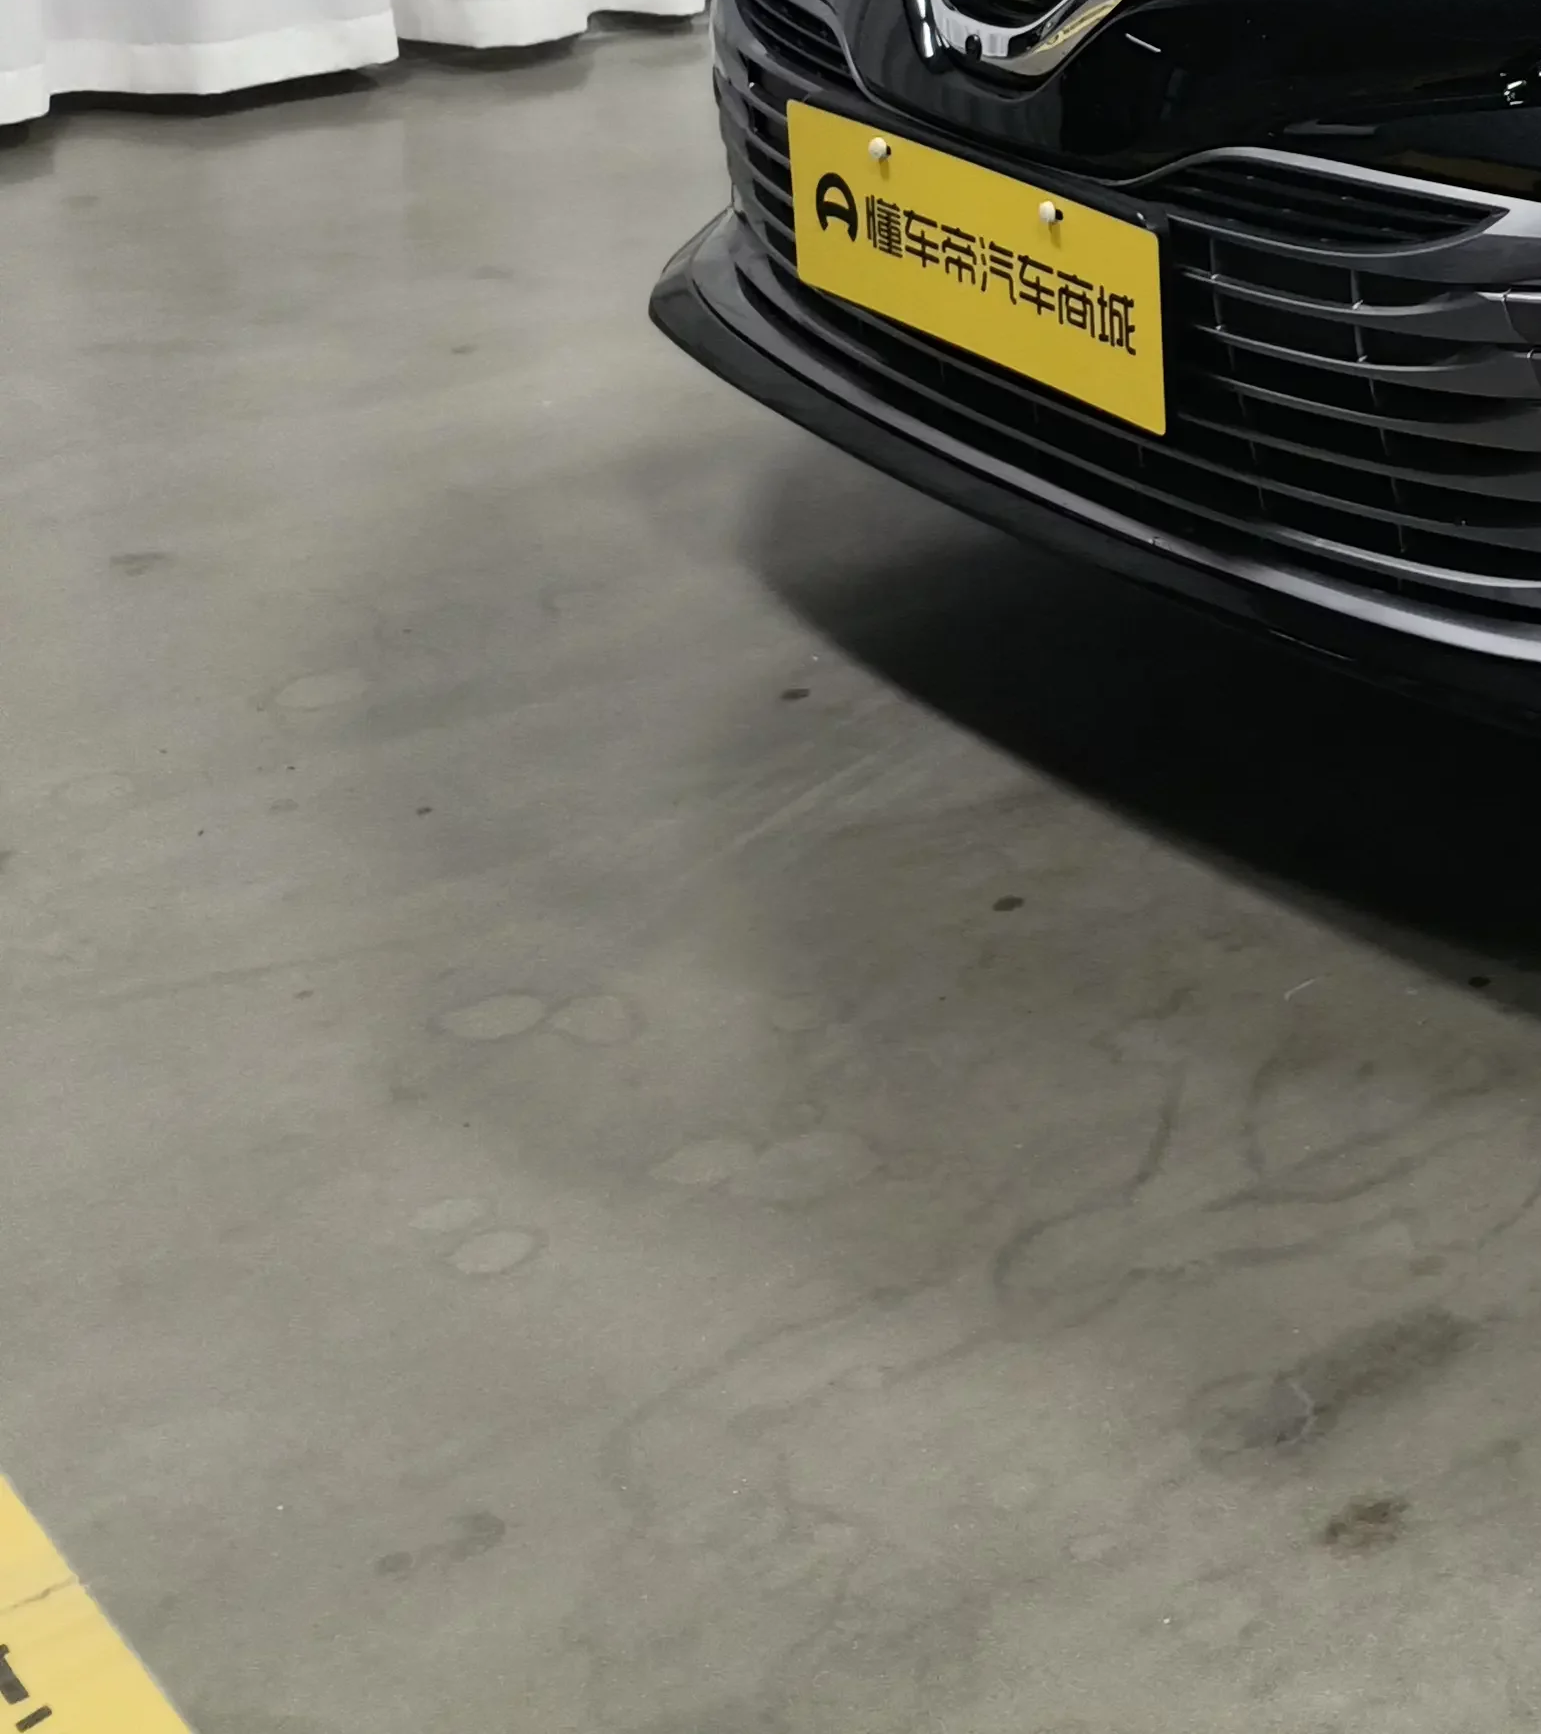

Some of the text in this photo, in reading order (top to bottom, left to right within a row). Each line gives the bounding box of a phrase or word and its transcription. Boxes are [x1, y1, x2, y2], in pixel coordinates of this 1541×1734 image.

[865, 193, 1137, 355] 懂车帝汽车商城
